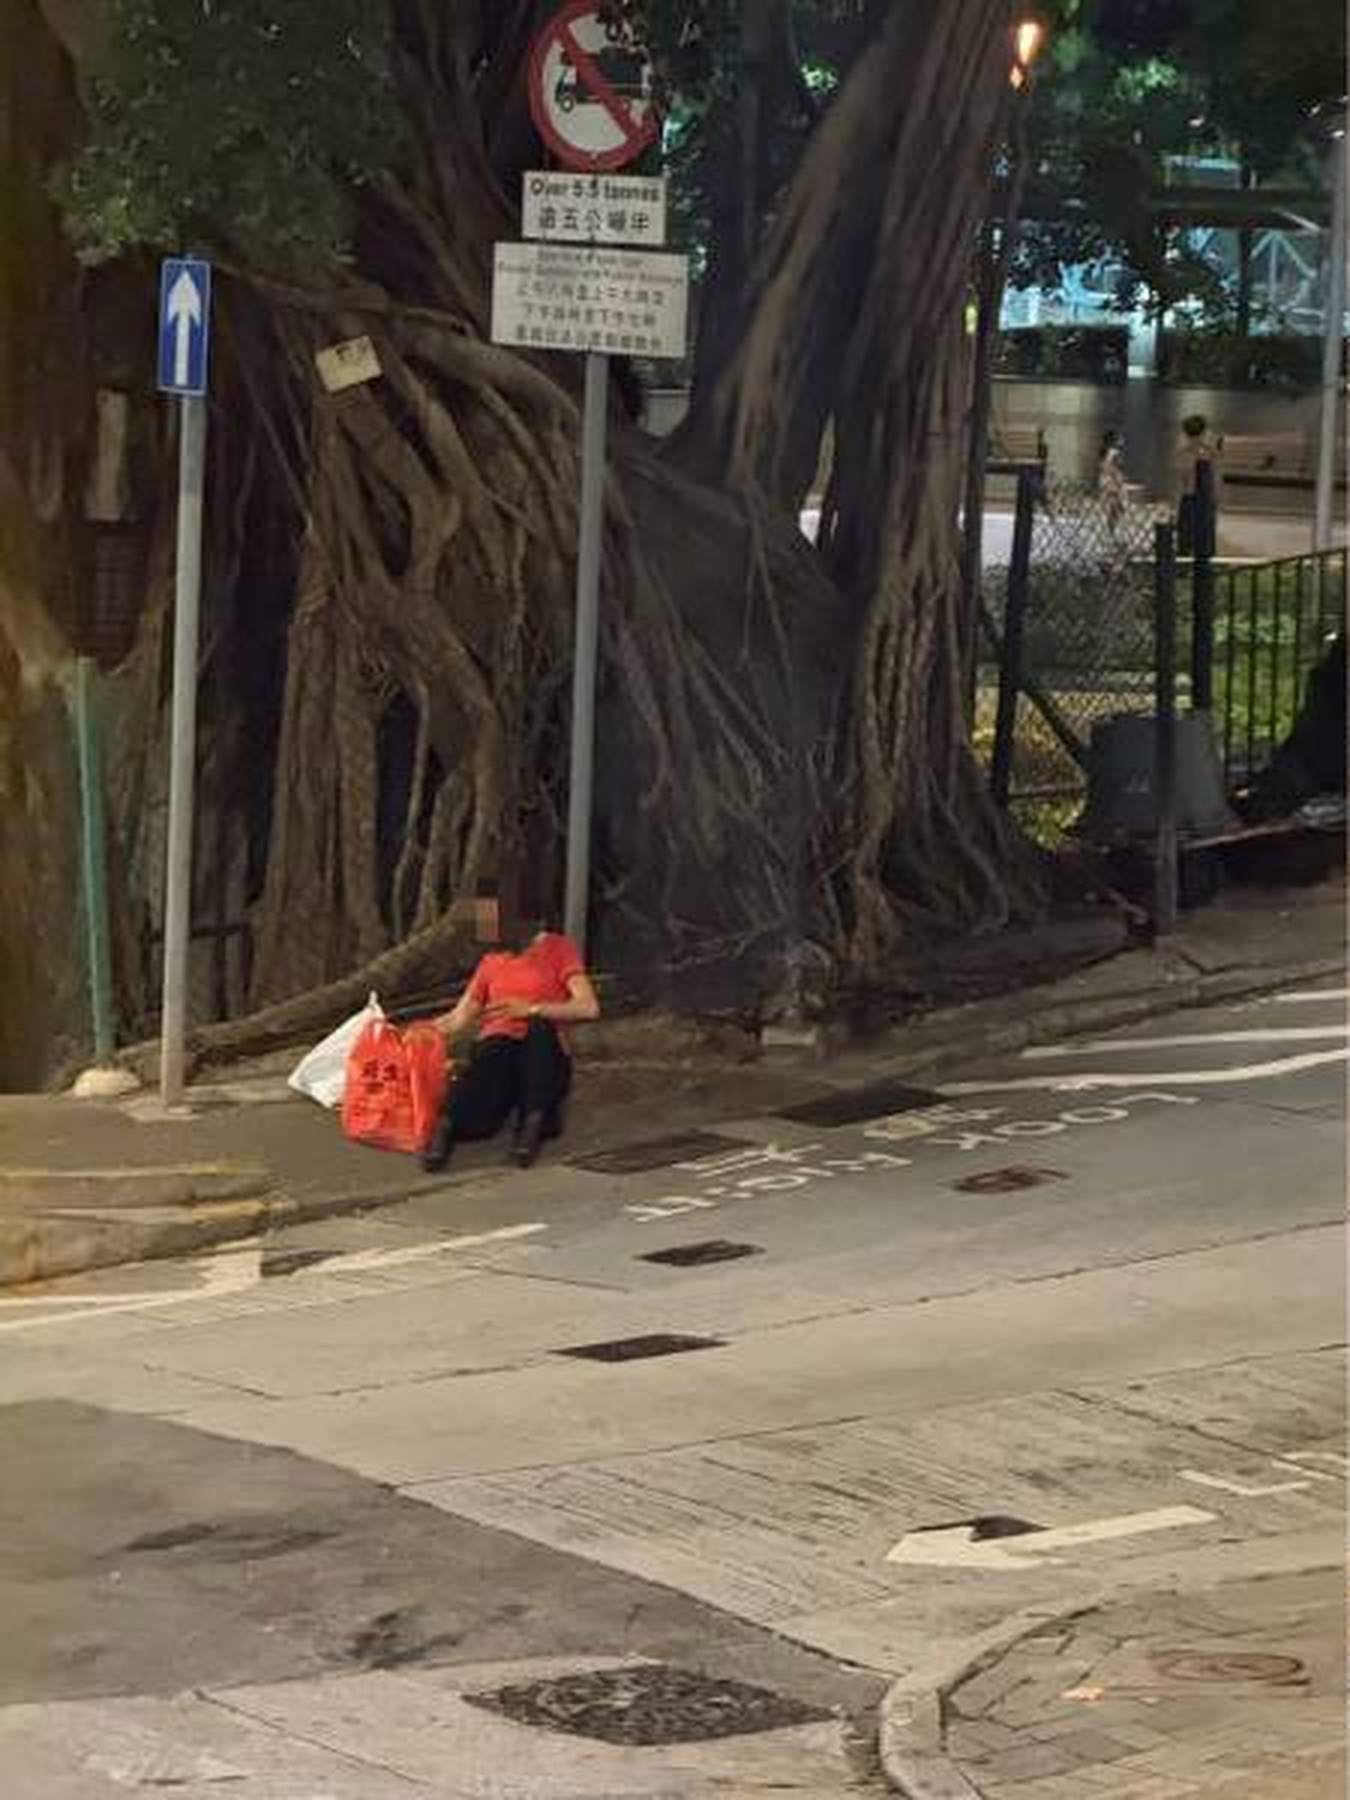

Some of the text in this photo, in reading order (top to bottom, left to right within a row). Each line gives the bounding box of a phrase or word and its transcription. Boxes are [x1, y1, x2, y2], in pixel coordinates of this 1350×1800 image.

[530, 178, 569, 196] Over
[604, 180, 660, 202] tonnes
[933, 1092, 1201, 1150] LOOK
